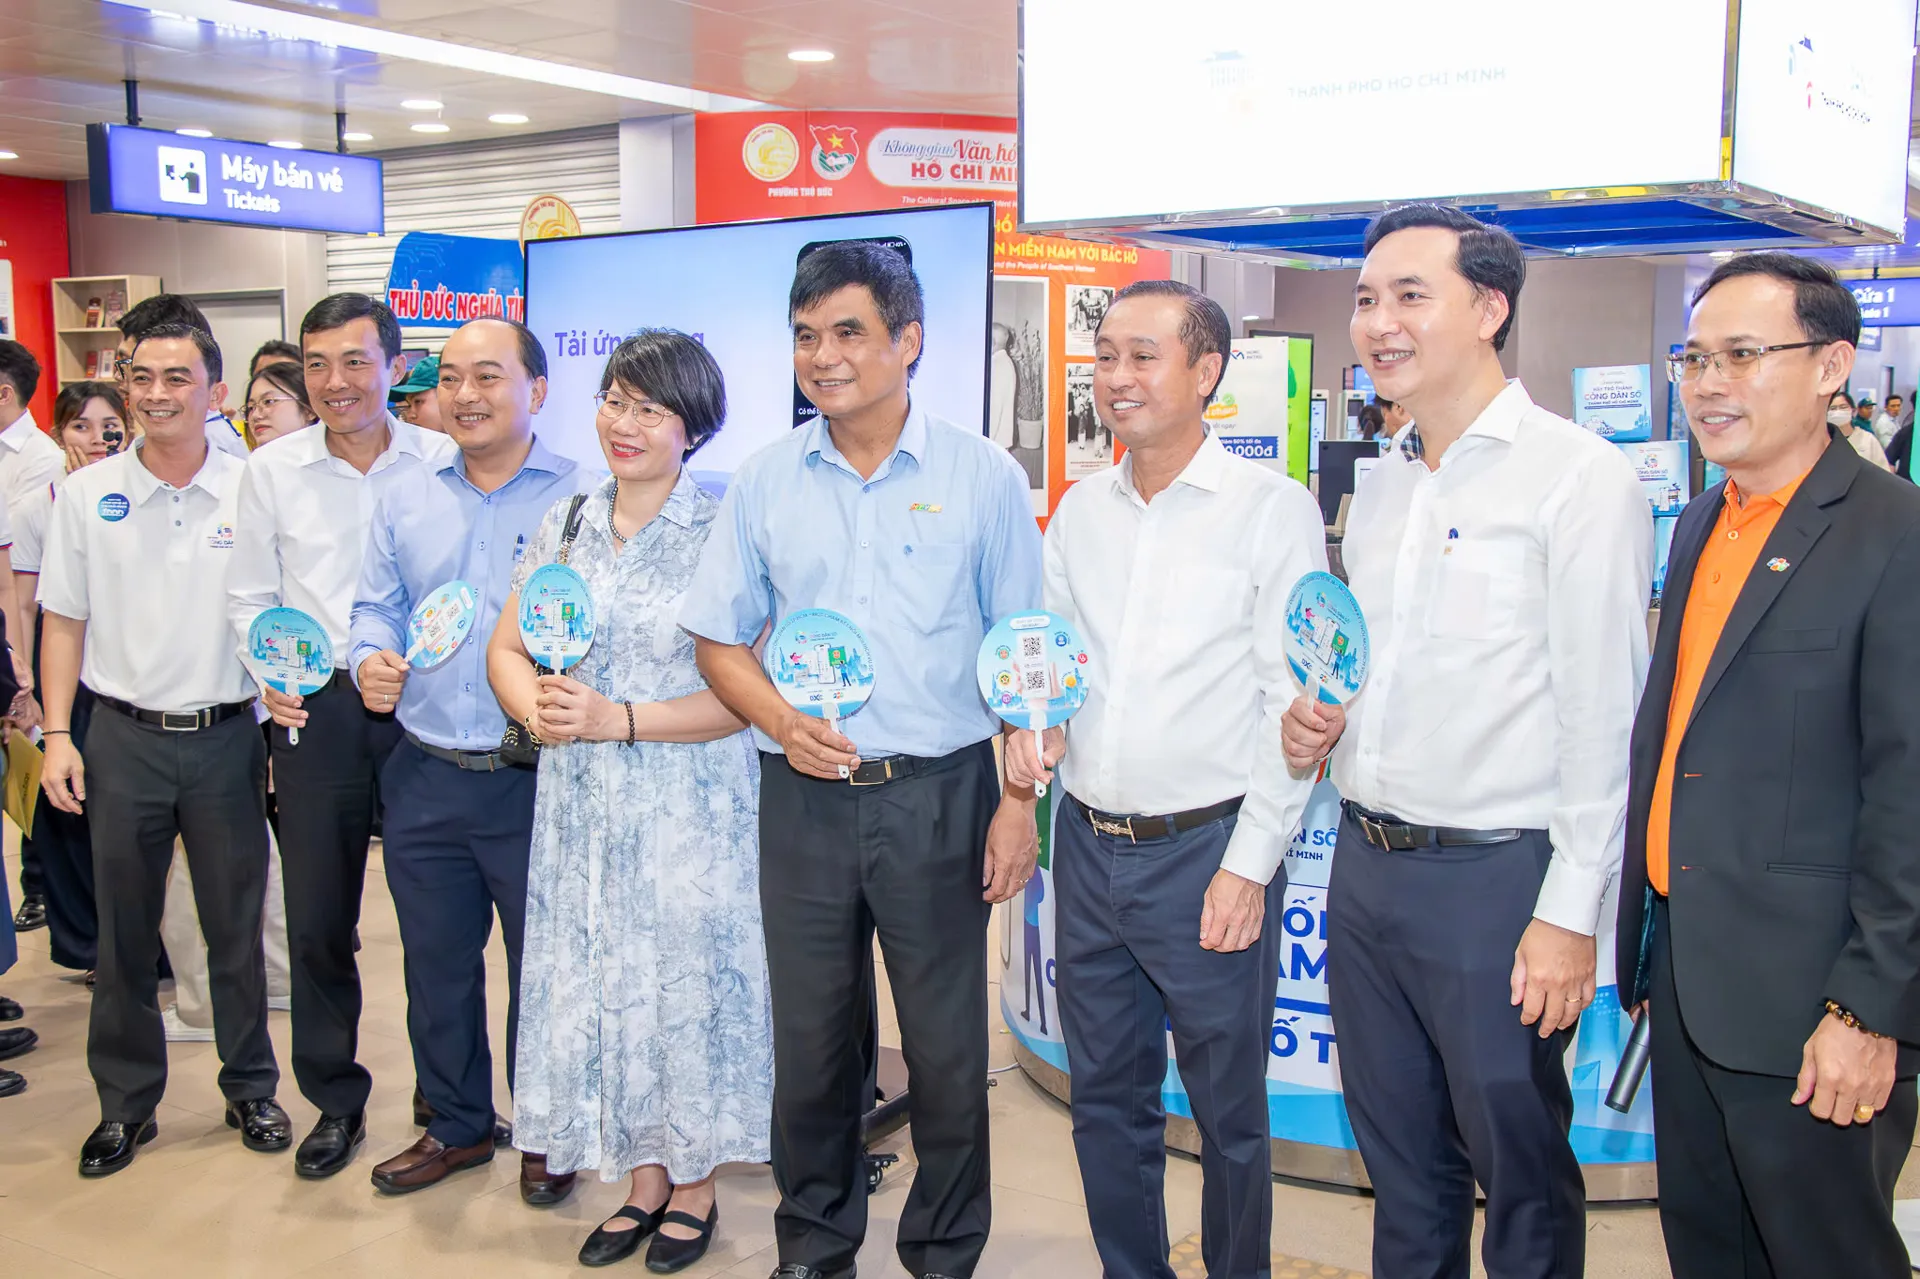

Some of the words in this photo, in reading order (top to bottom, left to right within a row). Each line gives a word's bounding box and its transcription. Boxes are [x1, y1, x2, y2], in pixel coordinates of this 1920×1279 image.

[954, 139, 991, 161] Văn
[996, 142, 1017, 162] hó
[221, 153, 269, 191] Máy
[223, 189, 281, 213] Tickets
[1047, 245, 1077, 260] NAM
[389, 279, 420, 319] THỦ
[422, 283, 454, 320] ĐỨC
[456, 287, 503, 320] NGHĨA
[1886, 287, 1895, 303] 1
[1861, 307, 1881, 318] ate
[1883, 306, 1889, 318] 1
[554, 330, 587, 357] Tải
[593, 329, 633, 356] ứn
[1296, 850, 1323, 860] MINH
